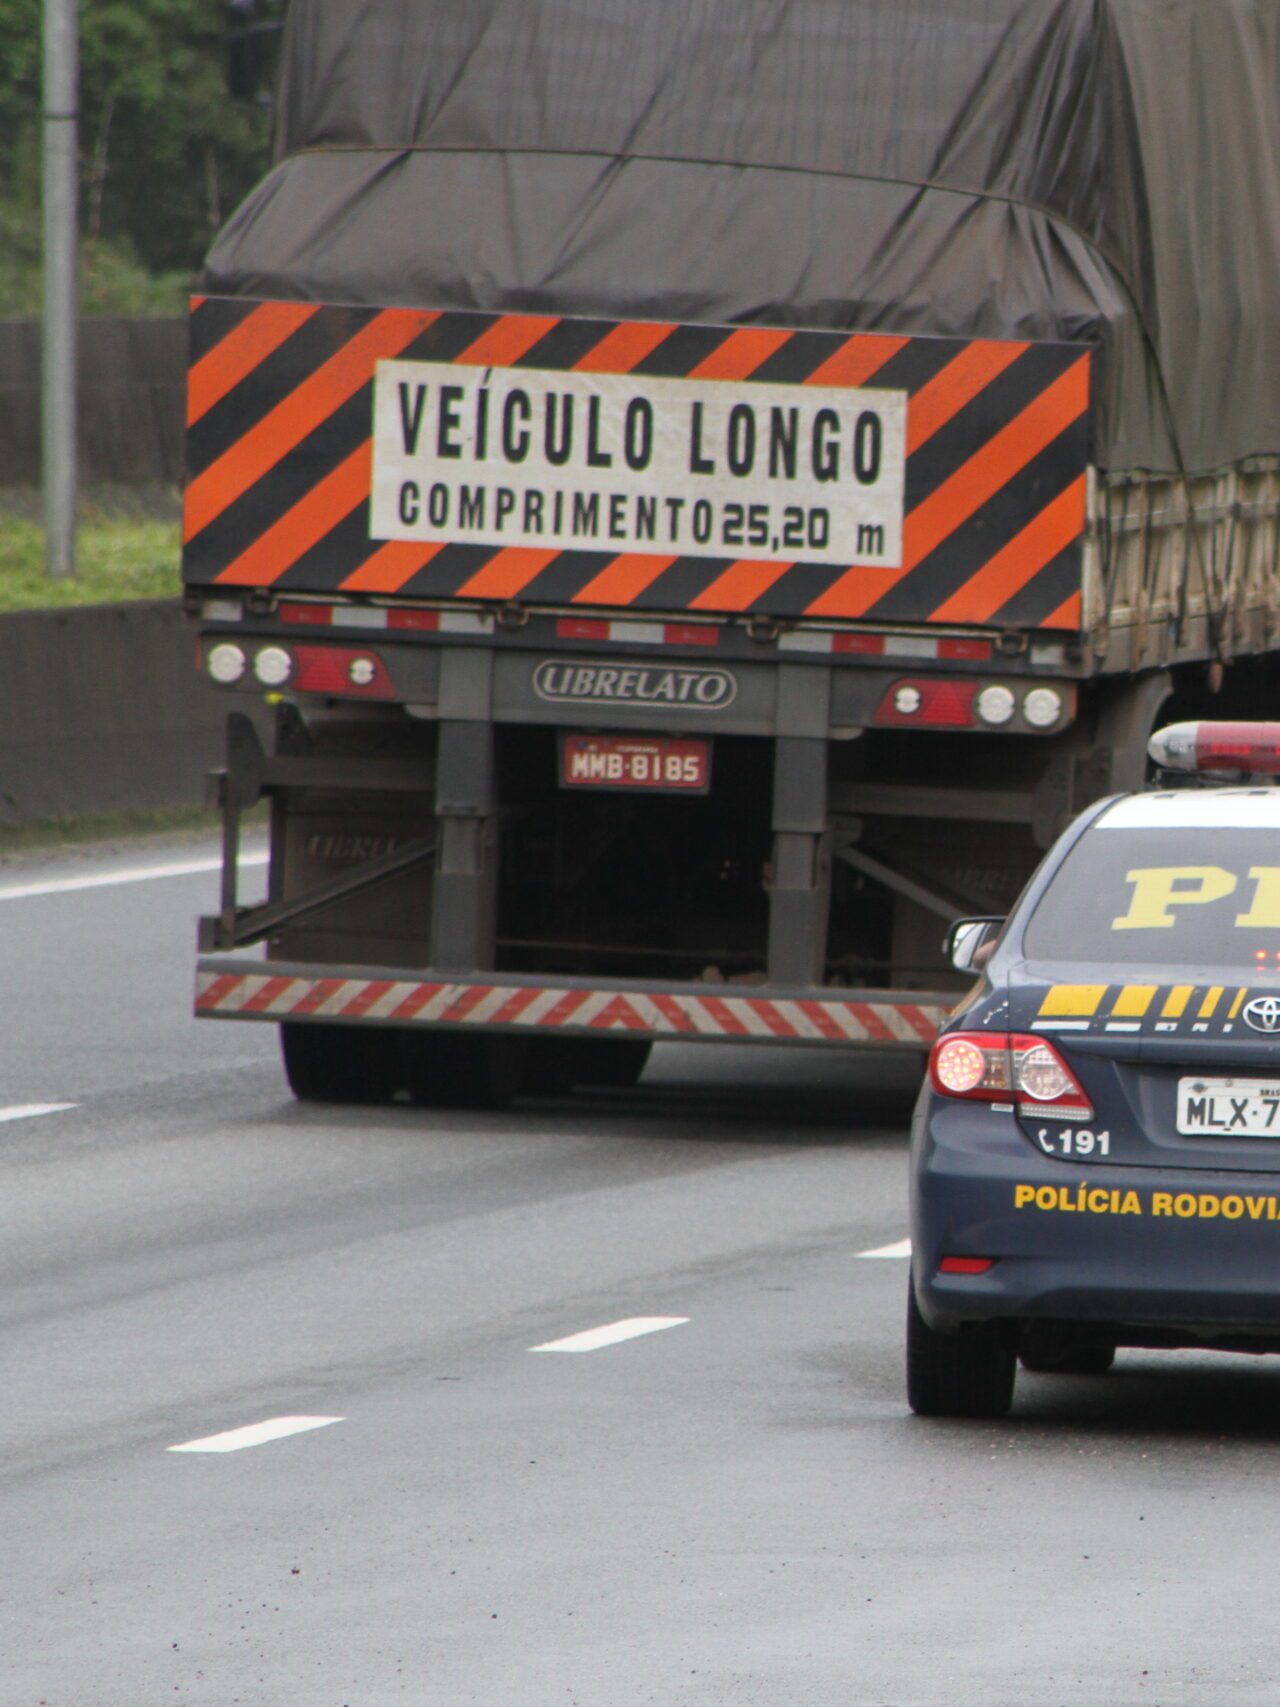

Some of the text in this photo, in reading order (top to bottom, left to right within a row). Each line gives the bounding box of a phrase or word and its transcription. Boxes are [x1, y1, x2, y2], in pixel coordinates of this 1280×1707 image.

[399, 367, 882, 485] VEÍCULO LONGO
[399, 480, 885, 556] COMPRIMENTO 25,20 m
[542, 666, 728, 702] LIBRELATO
[1059, 1128, 1110, 1156] 191
[1013, 1181, 1142, 1215] POLÍCIA
